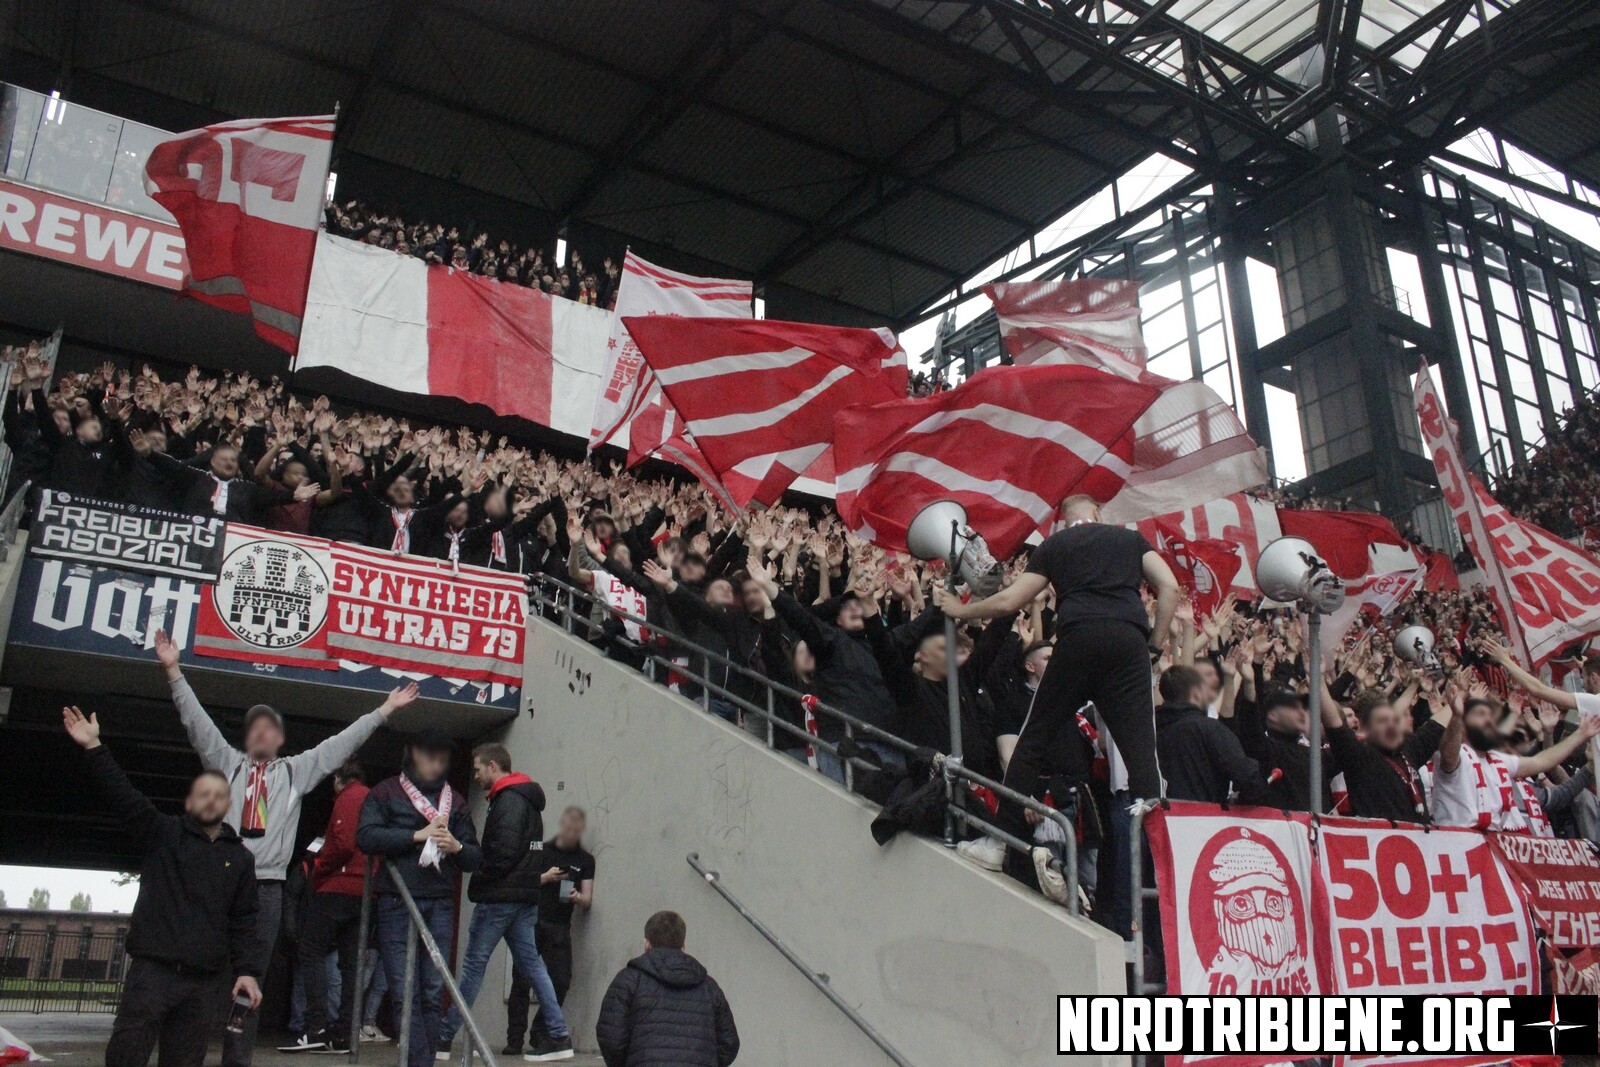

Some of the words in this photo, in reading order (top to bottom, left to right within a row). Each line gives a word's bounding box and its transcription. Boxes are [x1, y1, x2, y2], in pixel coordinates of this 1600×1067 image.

[0, 191, 186, 280] REWE
[233, 596, 310, 614] SYNTHESIA
[332, 562, 525, 625] SYNTHESIA
[338, 601, 470, 651] ULTRAS
[481, 626, 517, 659] 79
[1323, 832, 1513, 921] 50+1
[1536, 880, 1566, 899] WEG
[1565, 881, 1589, 900] MIT
[1338, 922, 1527, 989] BLEIBT.
